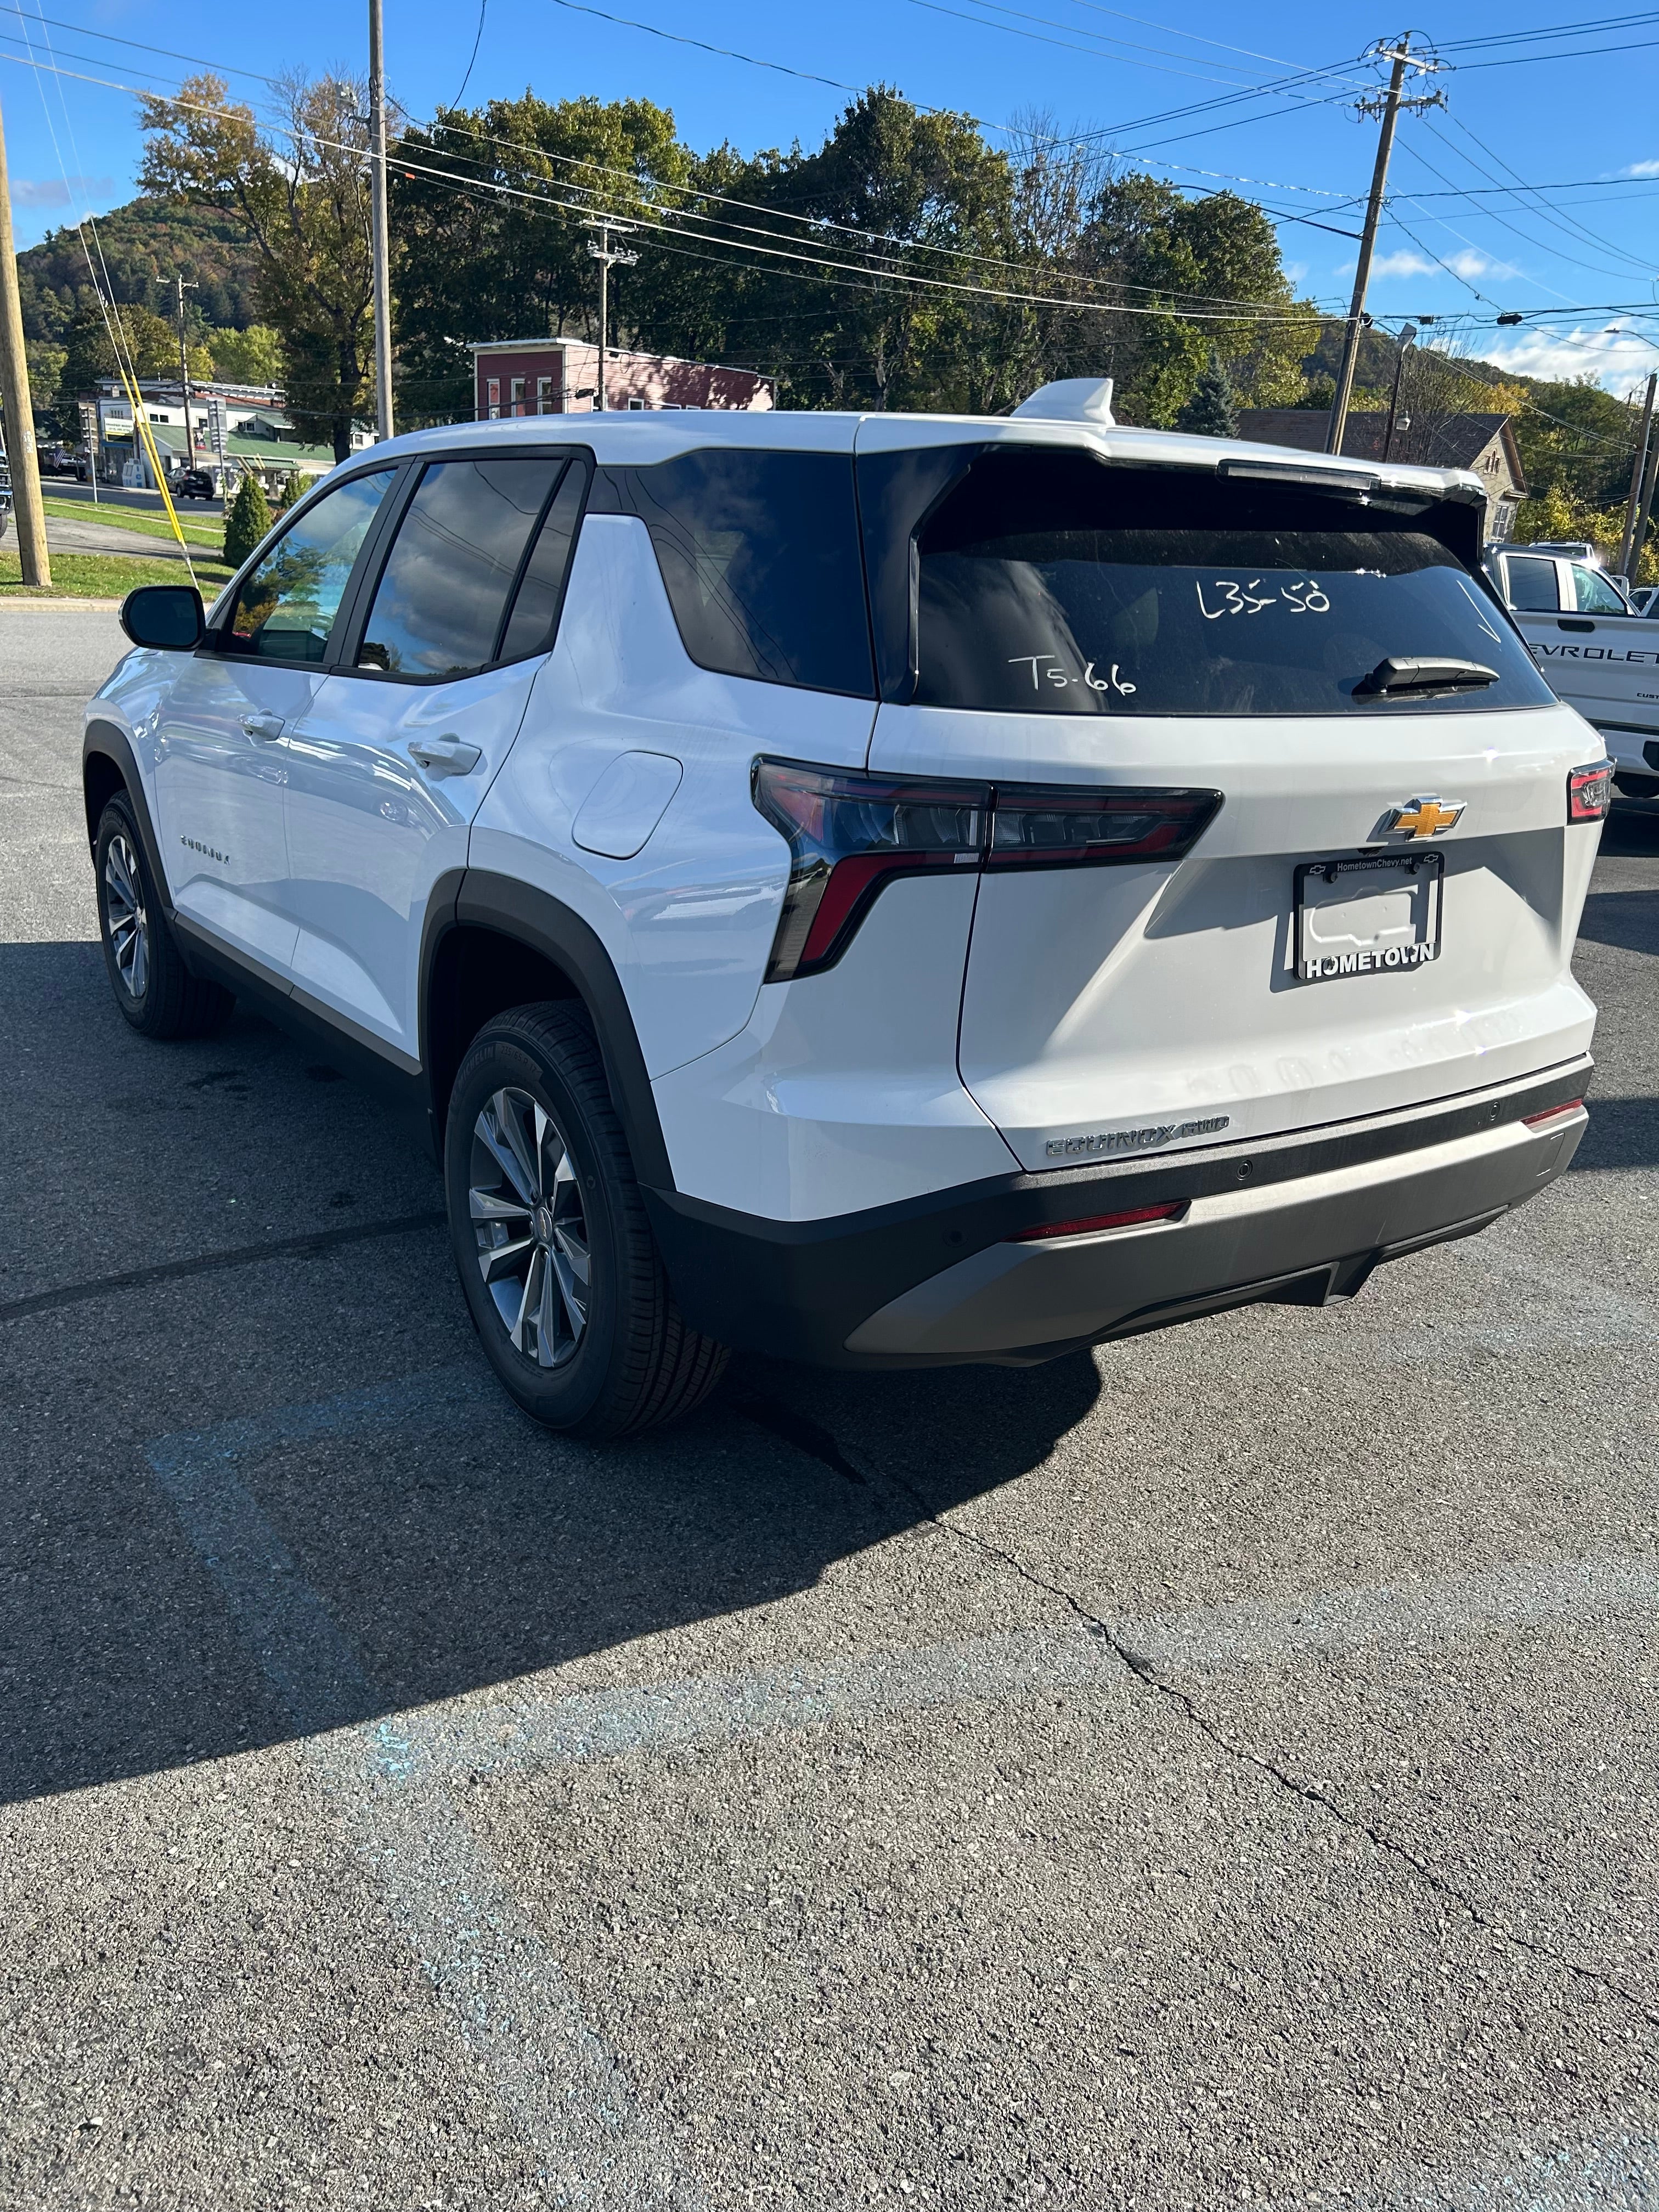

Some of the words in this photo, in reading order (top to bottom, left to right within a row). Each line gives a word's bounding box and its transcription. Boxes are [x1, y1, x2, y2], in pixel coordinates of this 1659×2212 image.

[1337, 856, 1413, 872] HometownChevy.net
[1306, 943, 1434, 978] HOMETOWN
[1046, 1124, 1177, 1156] EQUINOX
[1182, 1115, 1230, 1138] AWD
